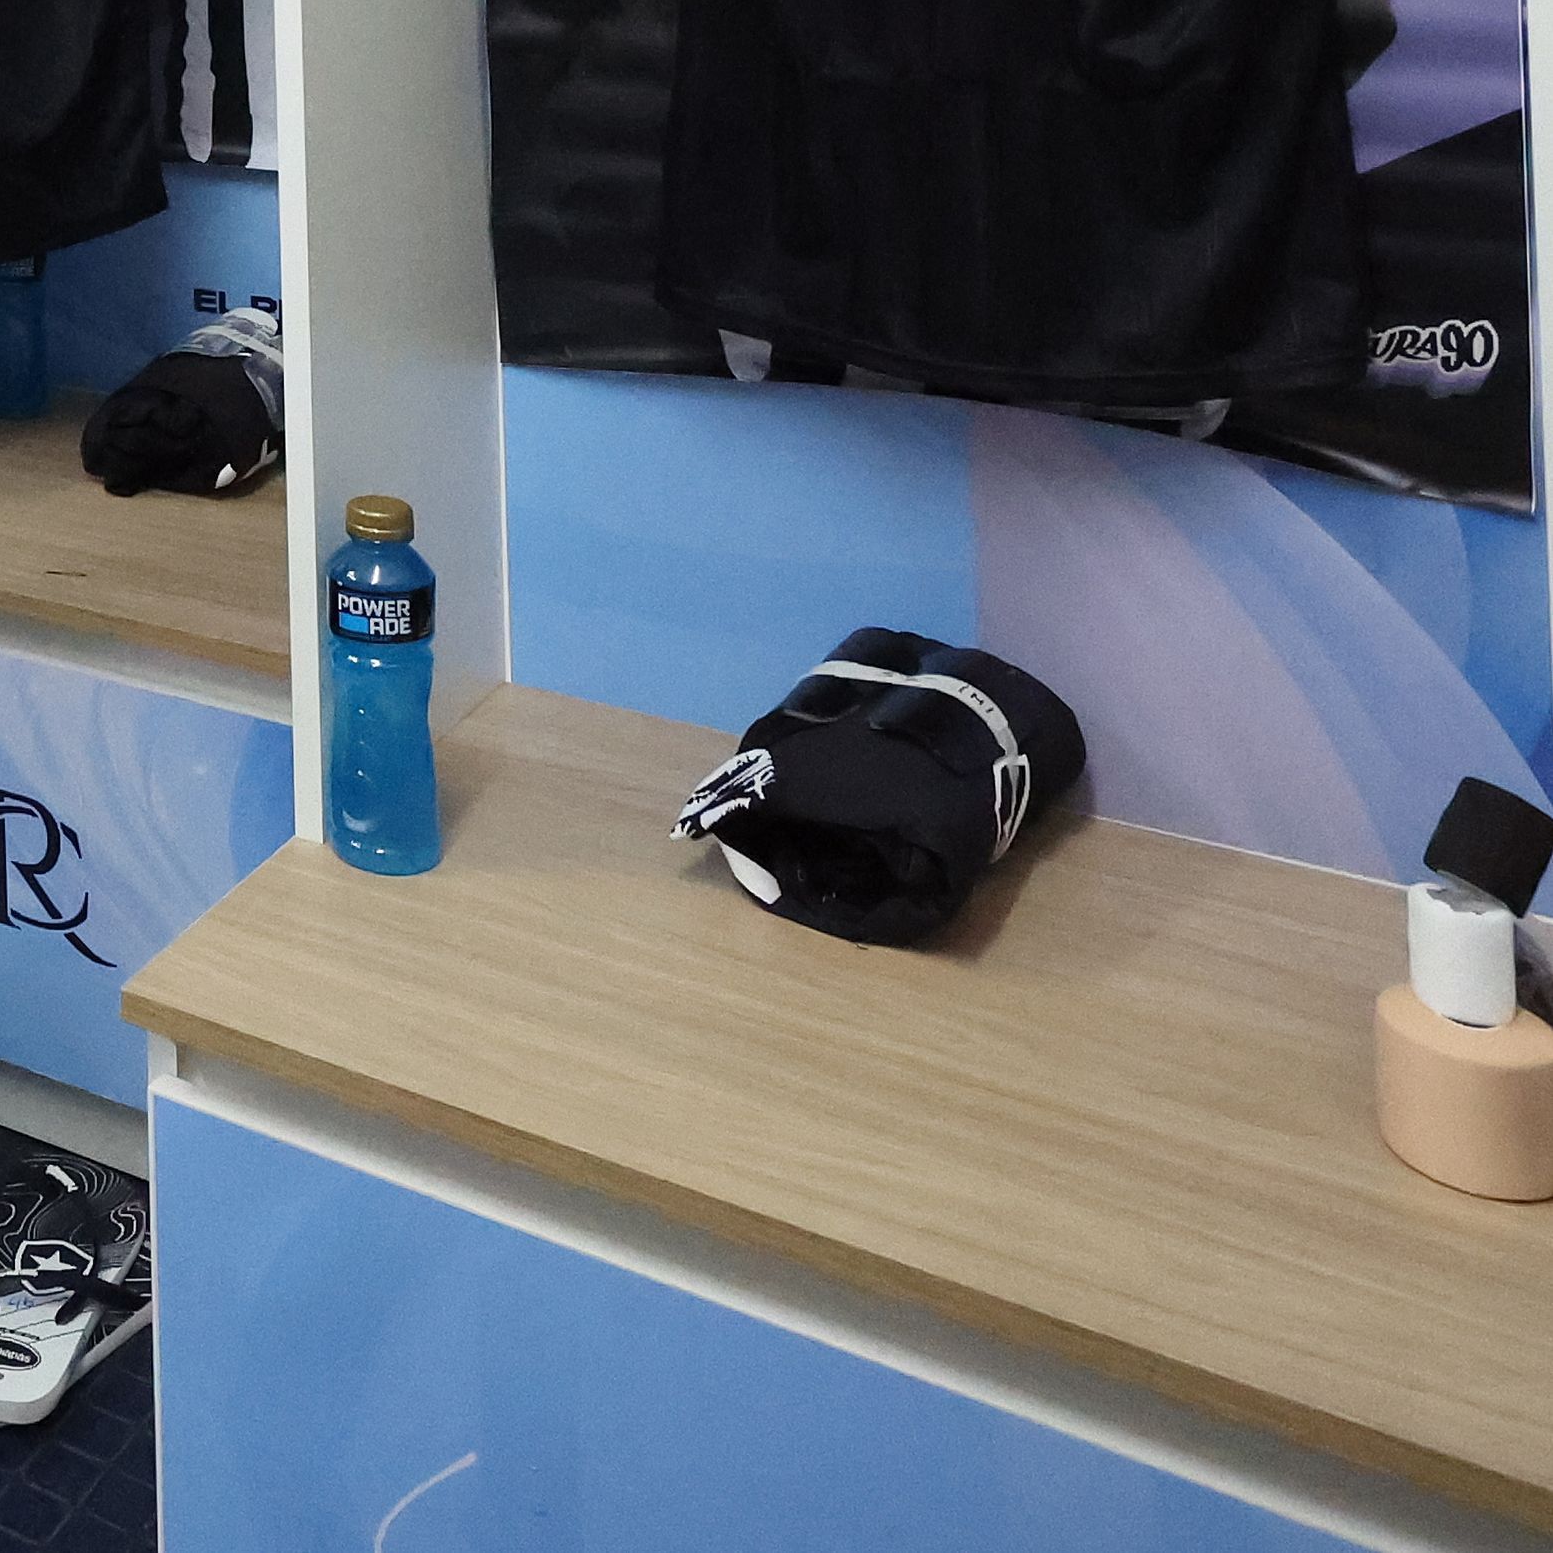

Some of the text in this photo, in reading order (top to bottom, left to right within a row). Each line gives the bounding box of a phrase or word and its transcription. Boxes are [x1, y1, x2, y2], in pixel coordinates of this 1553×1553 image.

[1368, 319, 1500, 375] URA90
[337, 592, 412, 618] POWER
[369, 617, 413, 636] ADE
